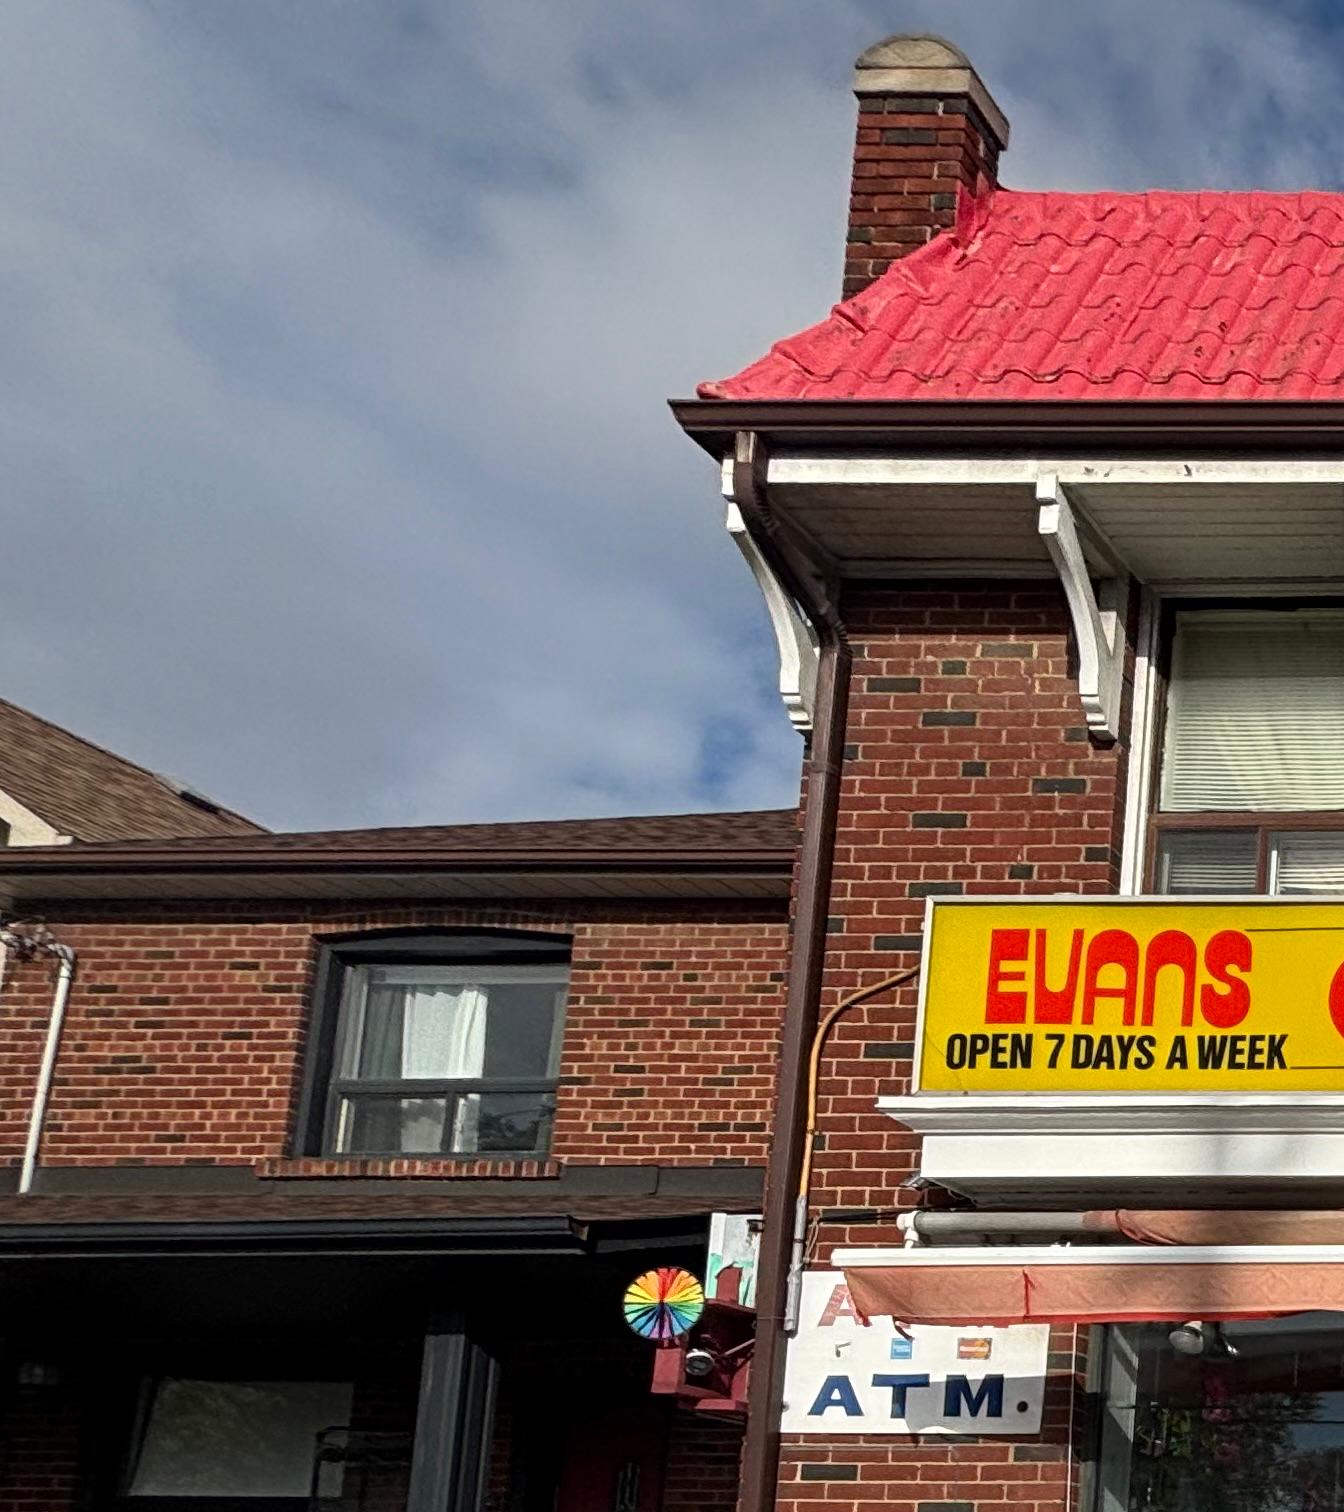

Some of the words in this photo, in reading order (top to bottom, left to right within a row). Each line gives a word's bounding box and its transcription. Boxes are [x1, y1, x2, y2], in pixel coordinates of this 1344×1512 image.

[984, 927, 1251, 1029] EVANS
[945, 1033, 1033, 1069] OPEN
[1045, 1034, 1066, 1069] 7
[1071, 1034, 1156, 1069] DAYS
[1166, 1035, 1188, 1069] A
[1197, 1034, 1289, 1069] WEEK
[807, 1373, 1004, 1418] ATM
